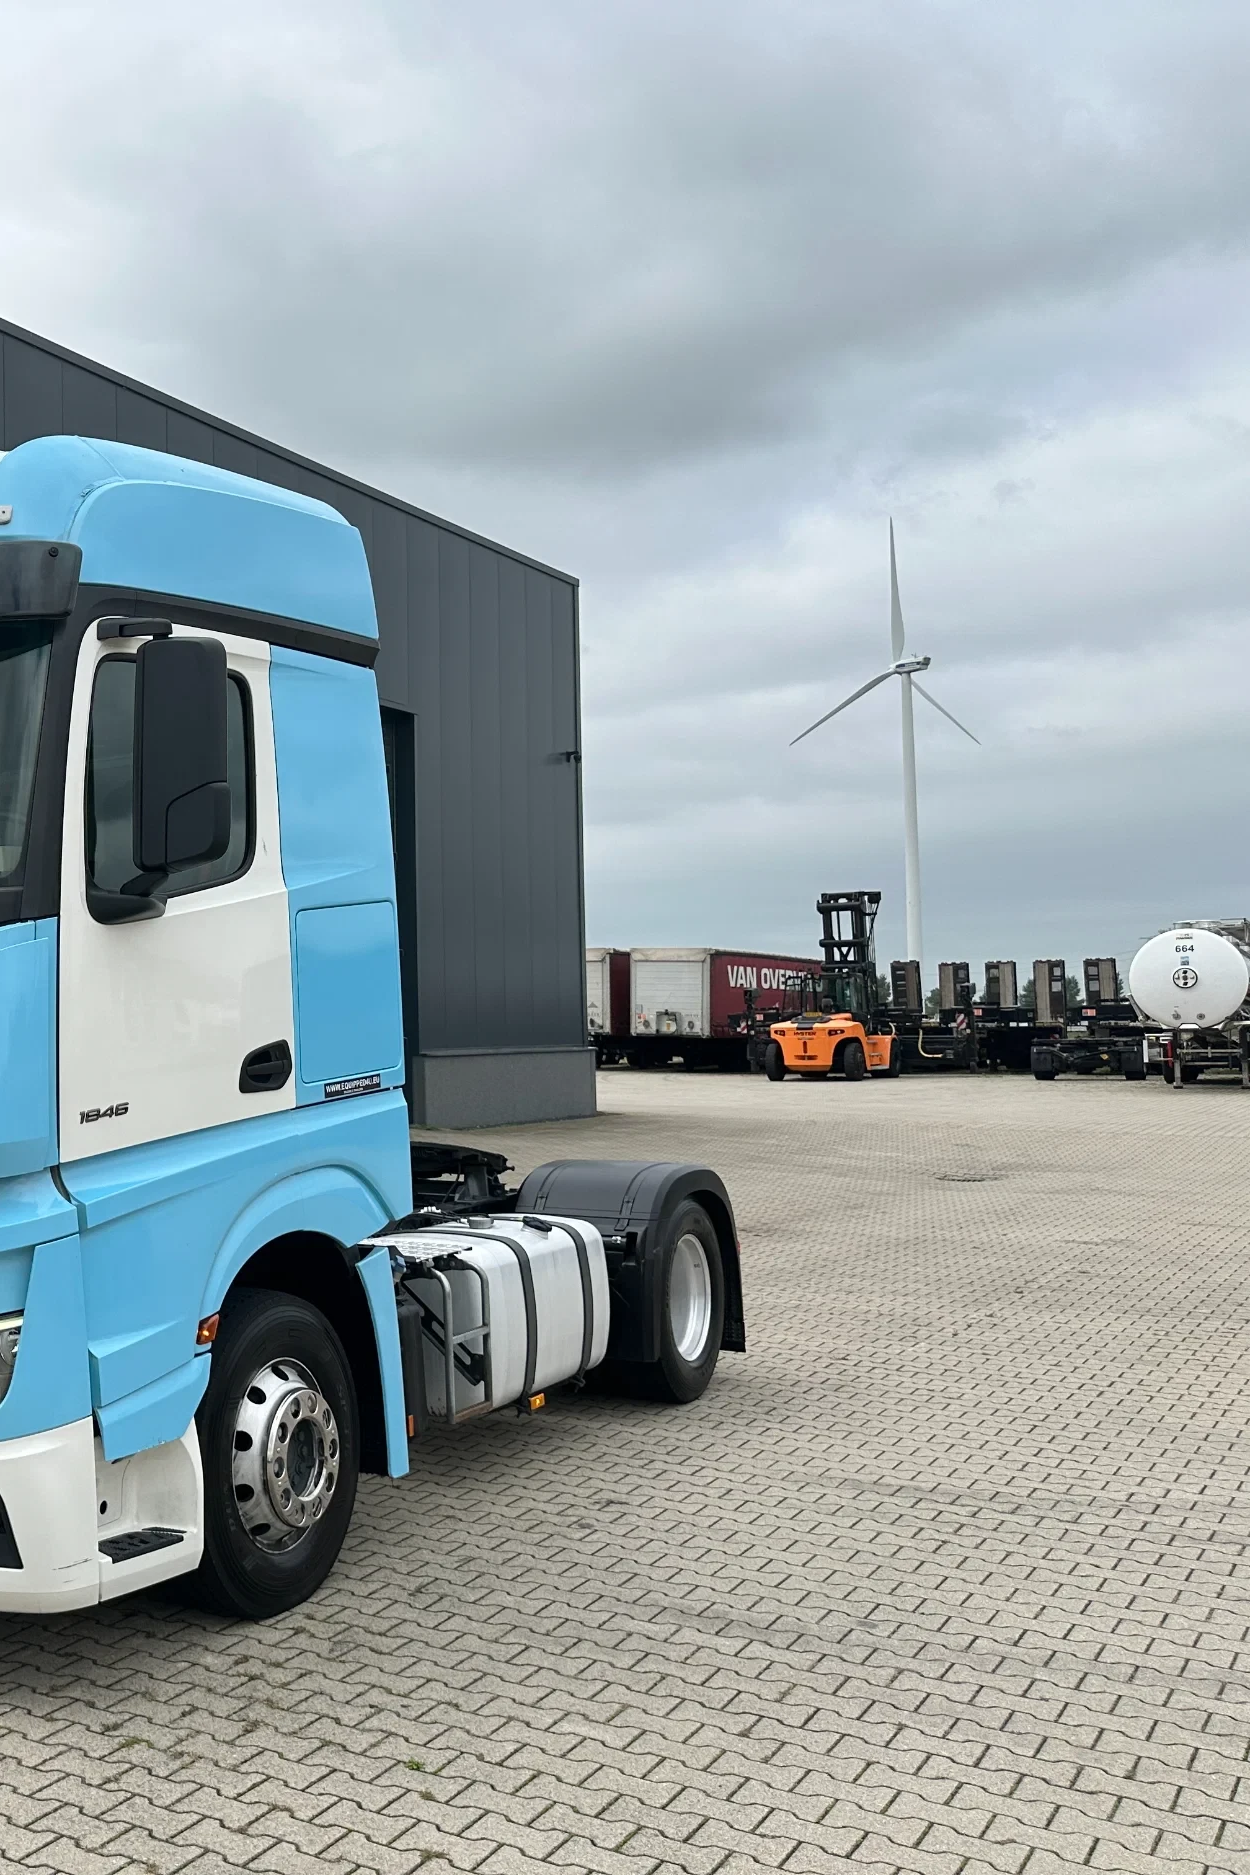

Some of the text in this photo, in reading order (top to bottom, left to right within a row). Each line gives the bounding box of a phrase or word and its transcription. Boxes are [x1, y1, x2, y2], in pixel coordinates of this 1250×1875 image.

[1175, 944, 1195, 953] 664
[727, 965, 758, 989] VAN
[325, 1076, 380, 1093] WWW.EQUIPPED4U.EU
[79, 1101, 130, 1125] 1846
